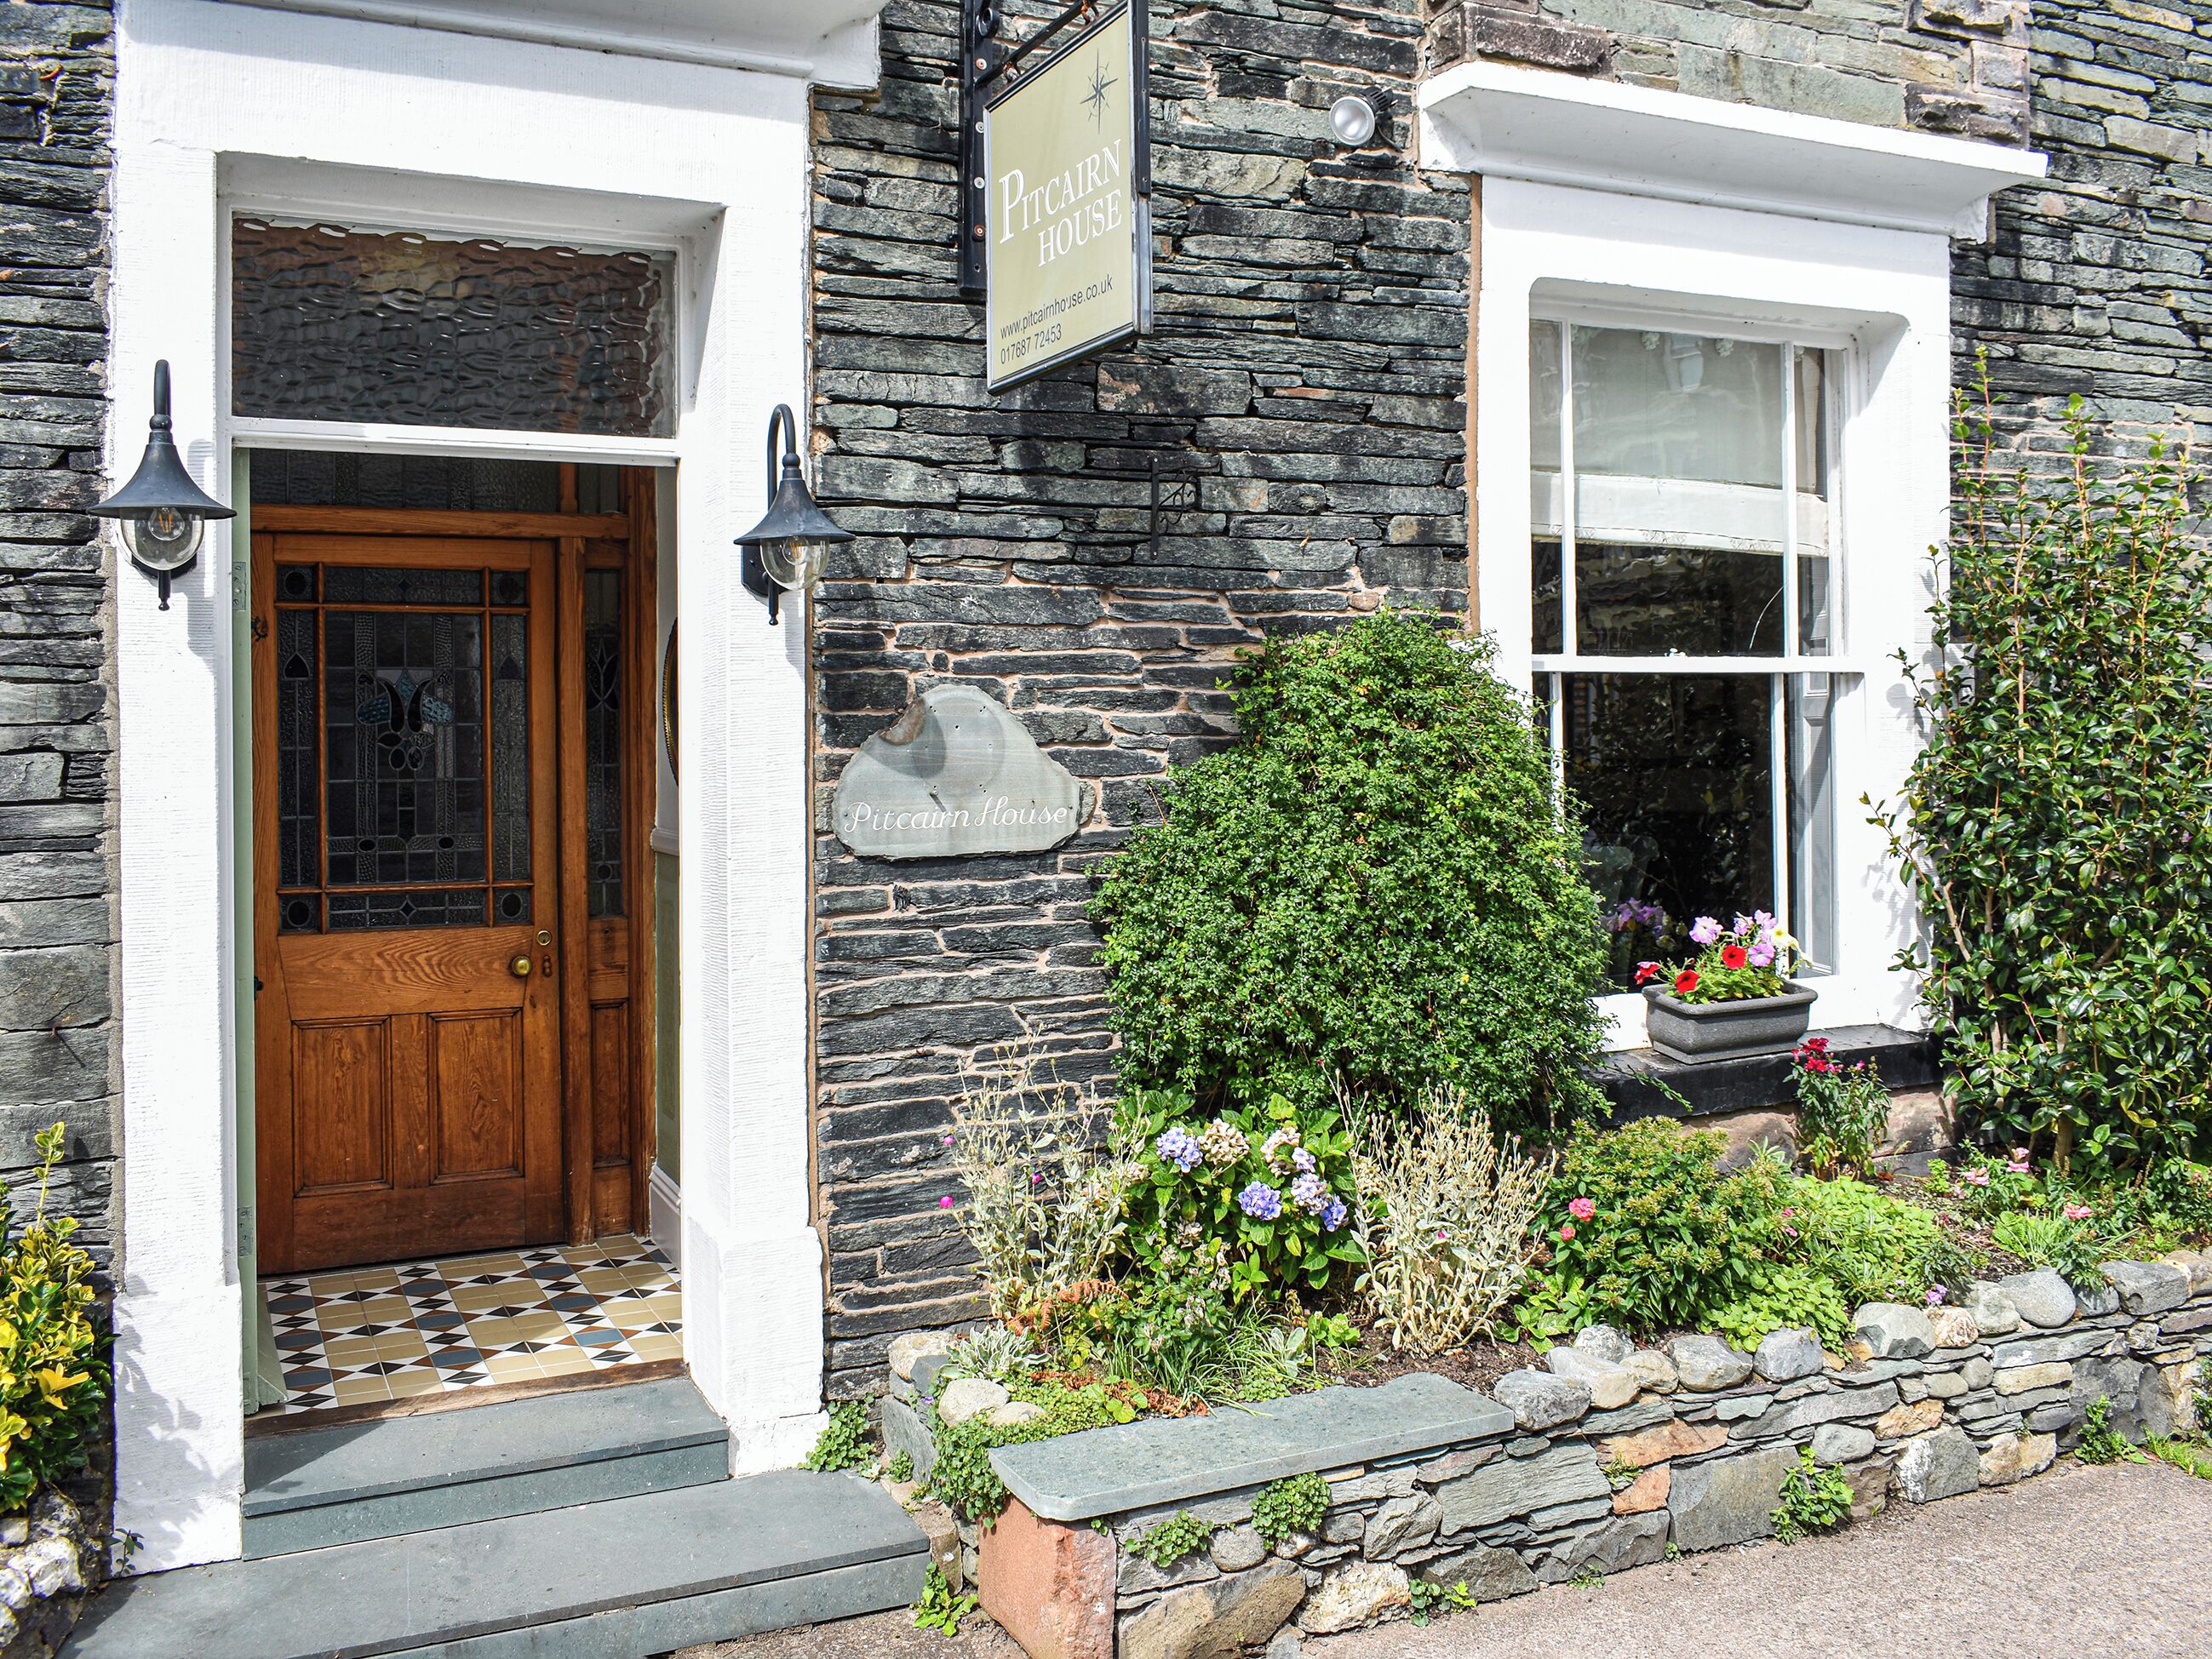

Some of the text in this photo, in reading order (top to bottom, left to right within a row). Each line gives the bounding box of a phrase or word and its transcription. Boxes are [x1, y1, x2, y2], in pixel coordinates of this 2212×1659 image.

[998, 138, 1122, 244] PITCAIRN
[1037, 190, 1122, 268] HOUSE
[1000, 274, 1113, 339] www.pitcairnhouse.co.uk
[1000, 323, 1063, 364] 017687 72453
[844, 796, 1068, 832] Pitcairn House
